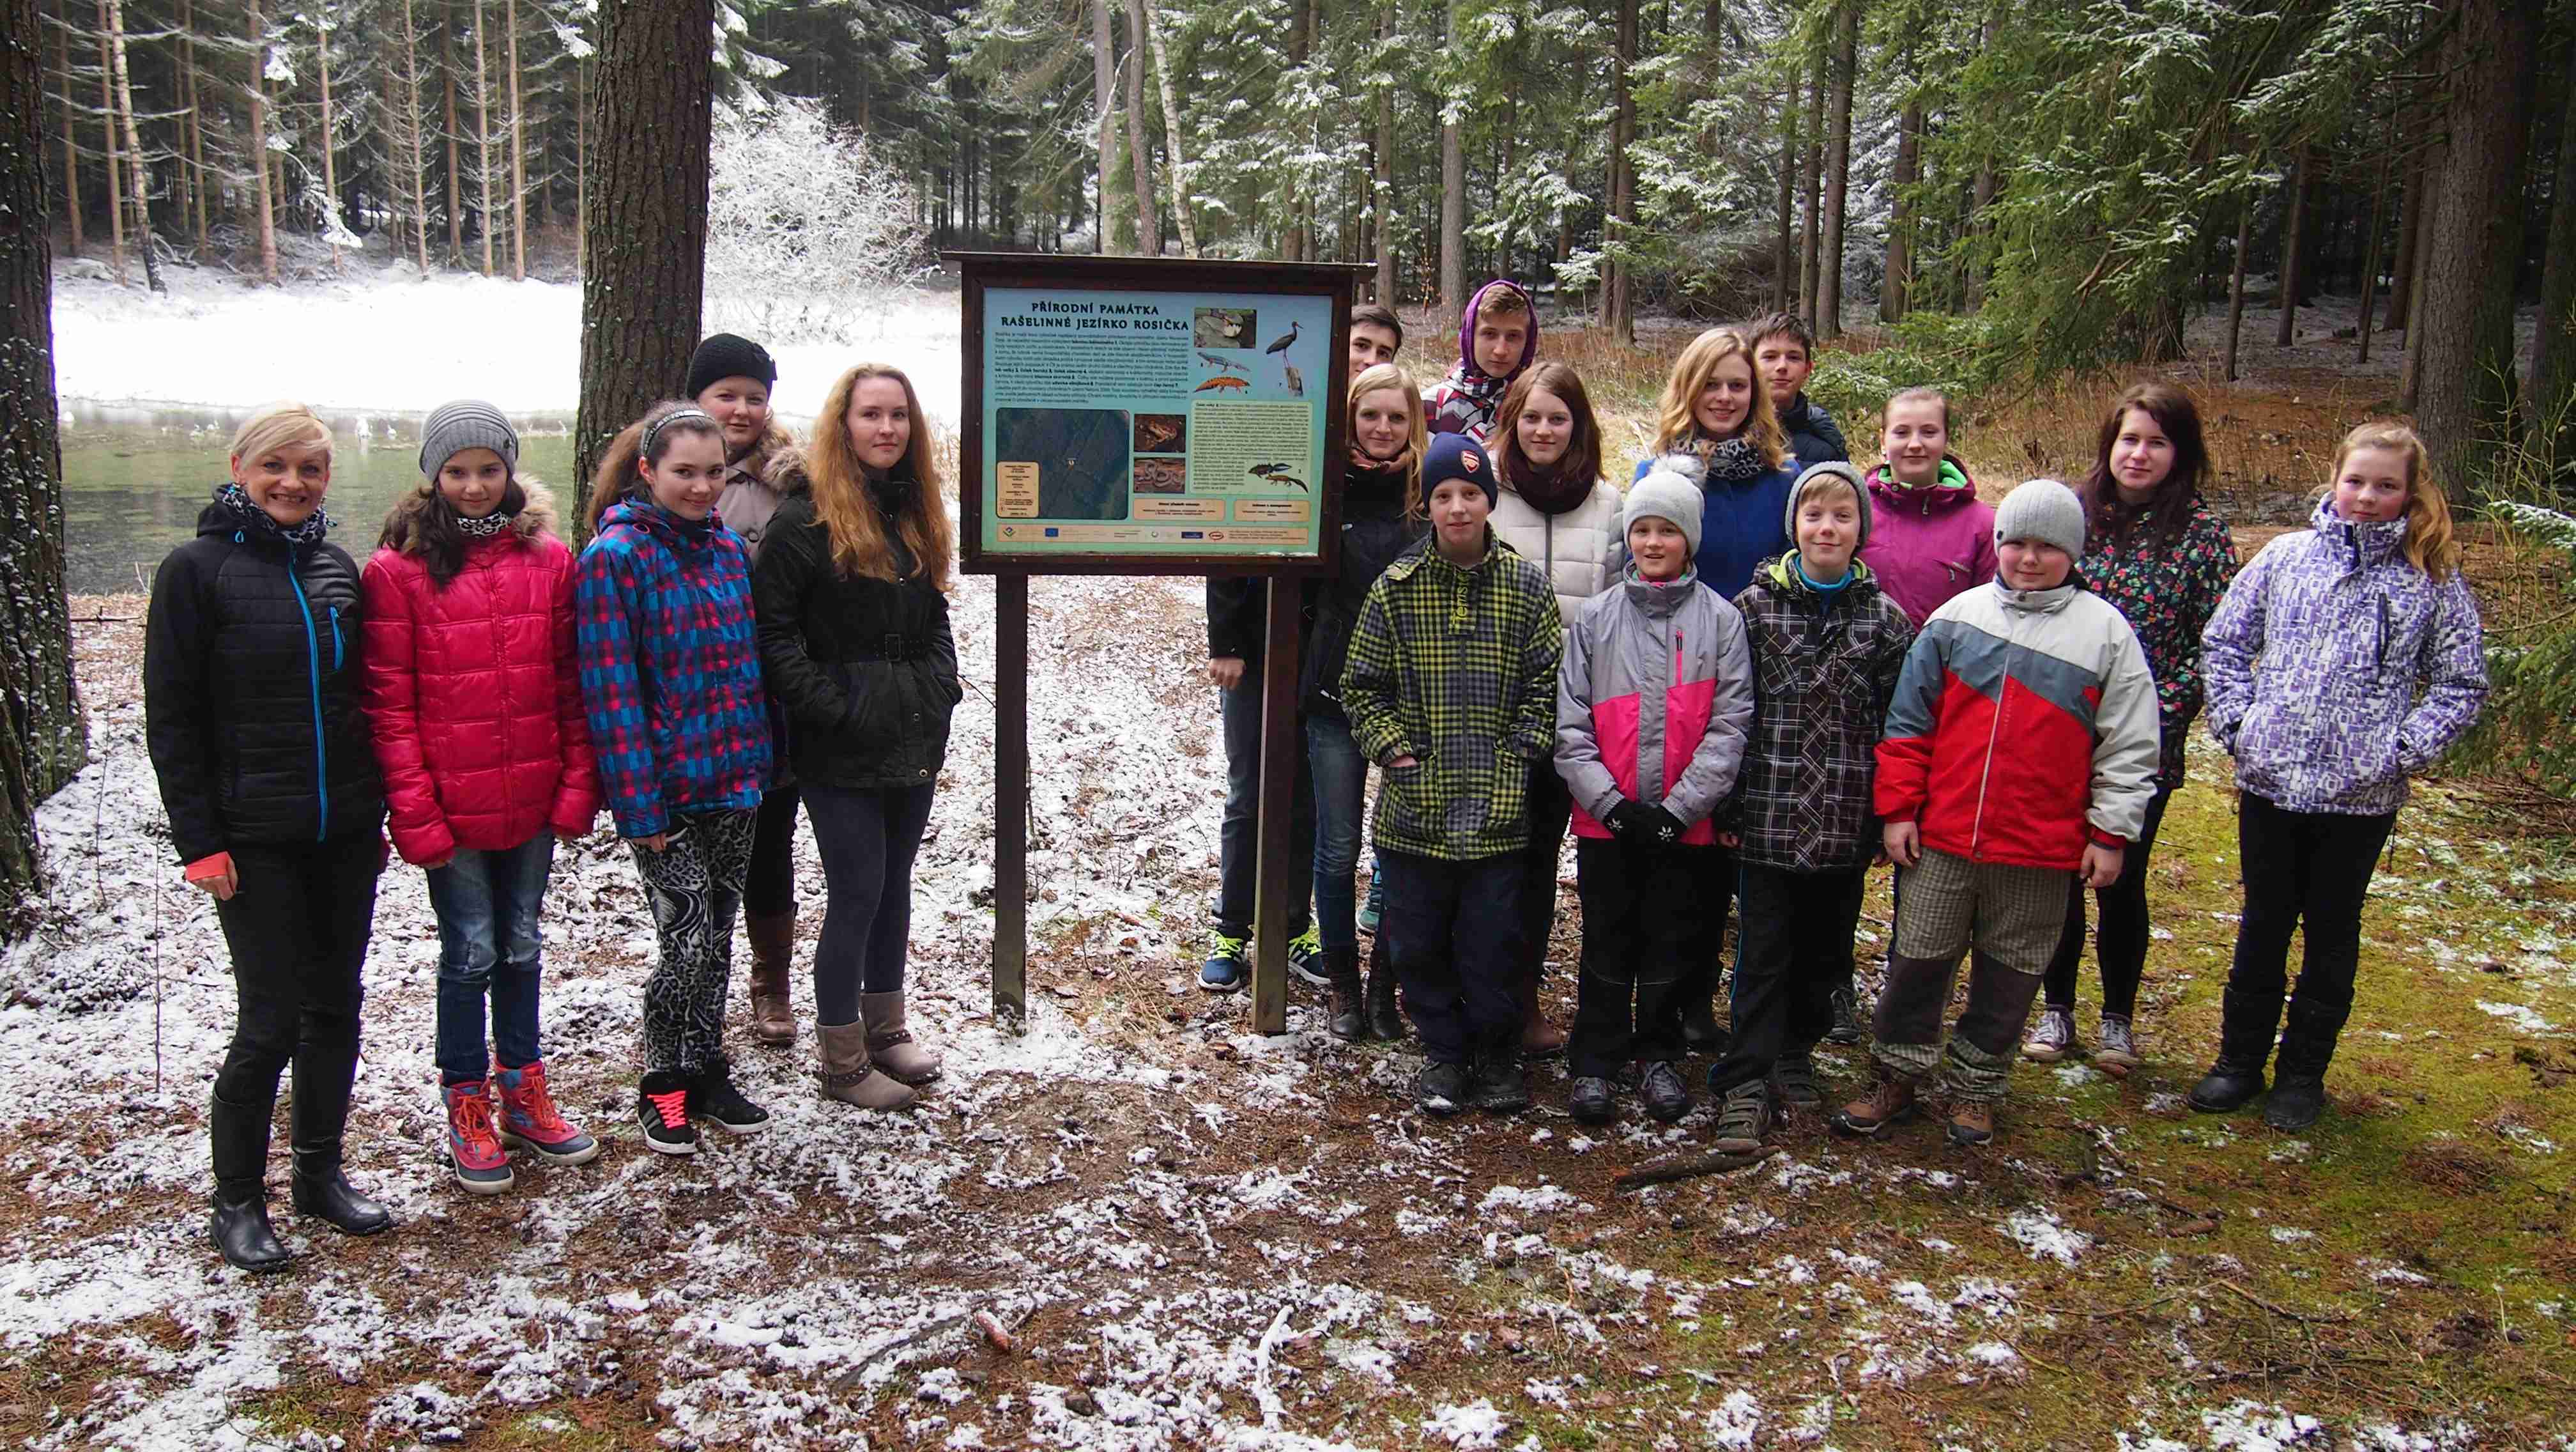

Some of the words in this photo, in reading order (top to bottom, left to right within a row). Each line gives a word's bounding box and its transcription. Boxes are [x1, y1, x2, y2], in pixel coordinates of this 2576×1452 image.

[1032, 301, 1094, 314] PŘÍRODNÍ
[1100, 303, 1159, 315] PAMÁTKA
[1001, 315, 1071, 328] RAŠELINNÉ
[1076, 317, 1128, 330] JEZÍRKO
[1134, 319, 1189, 330] ROSIČKA
